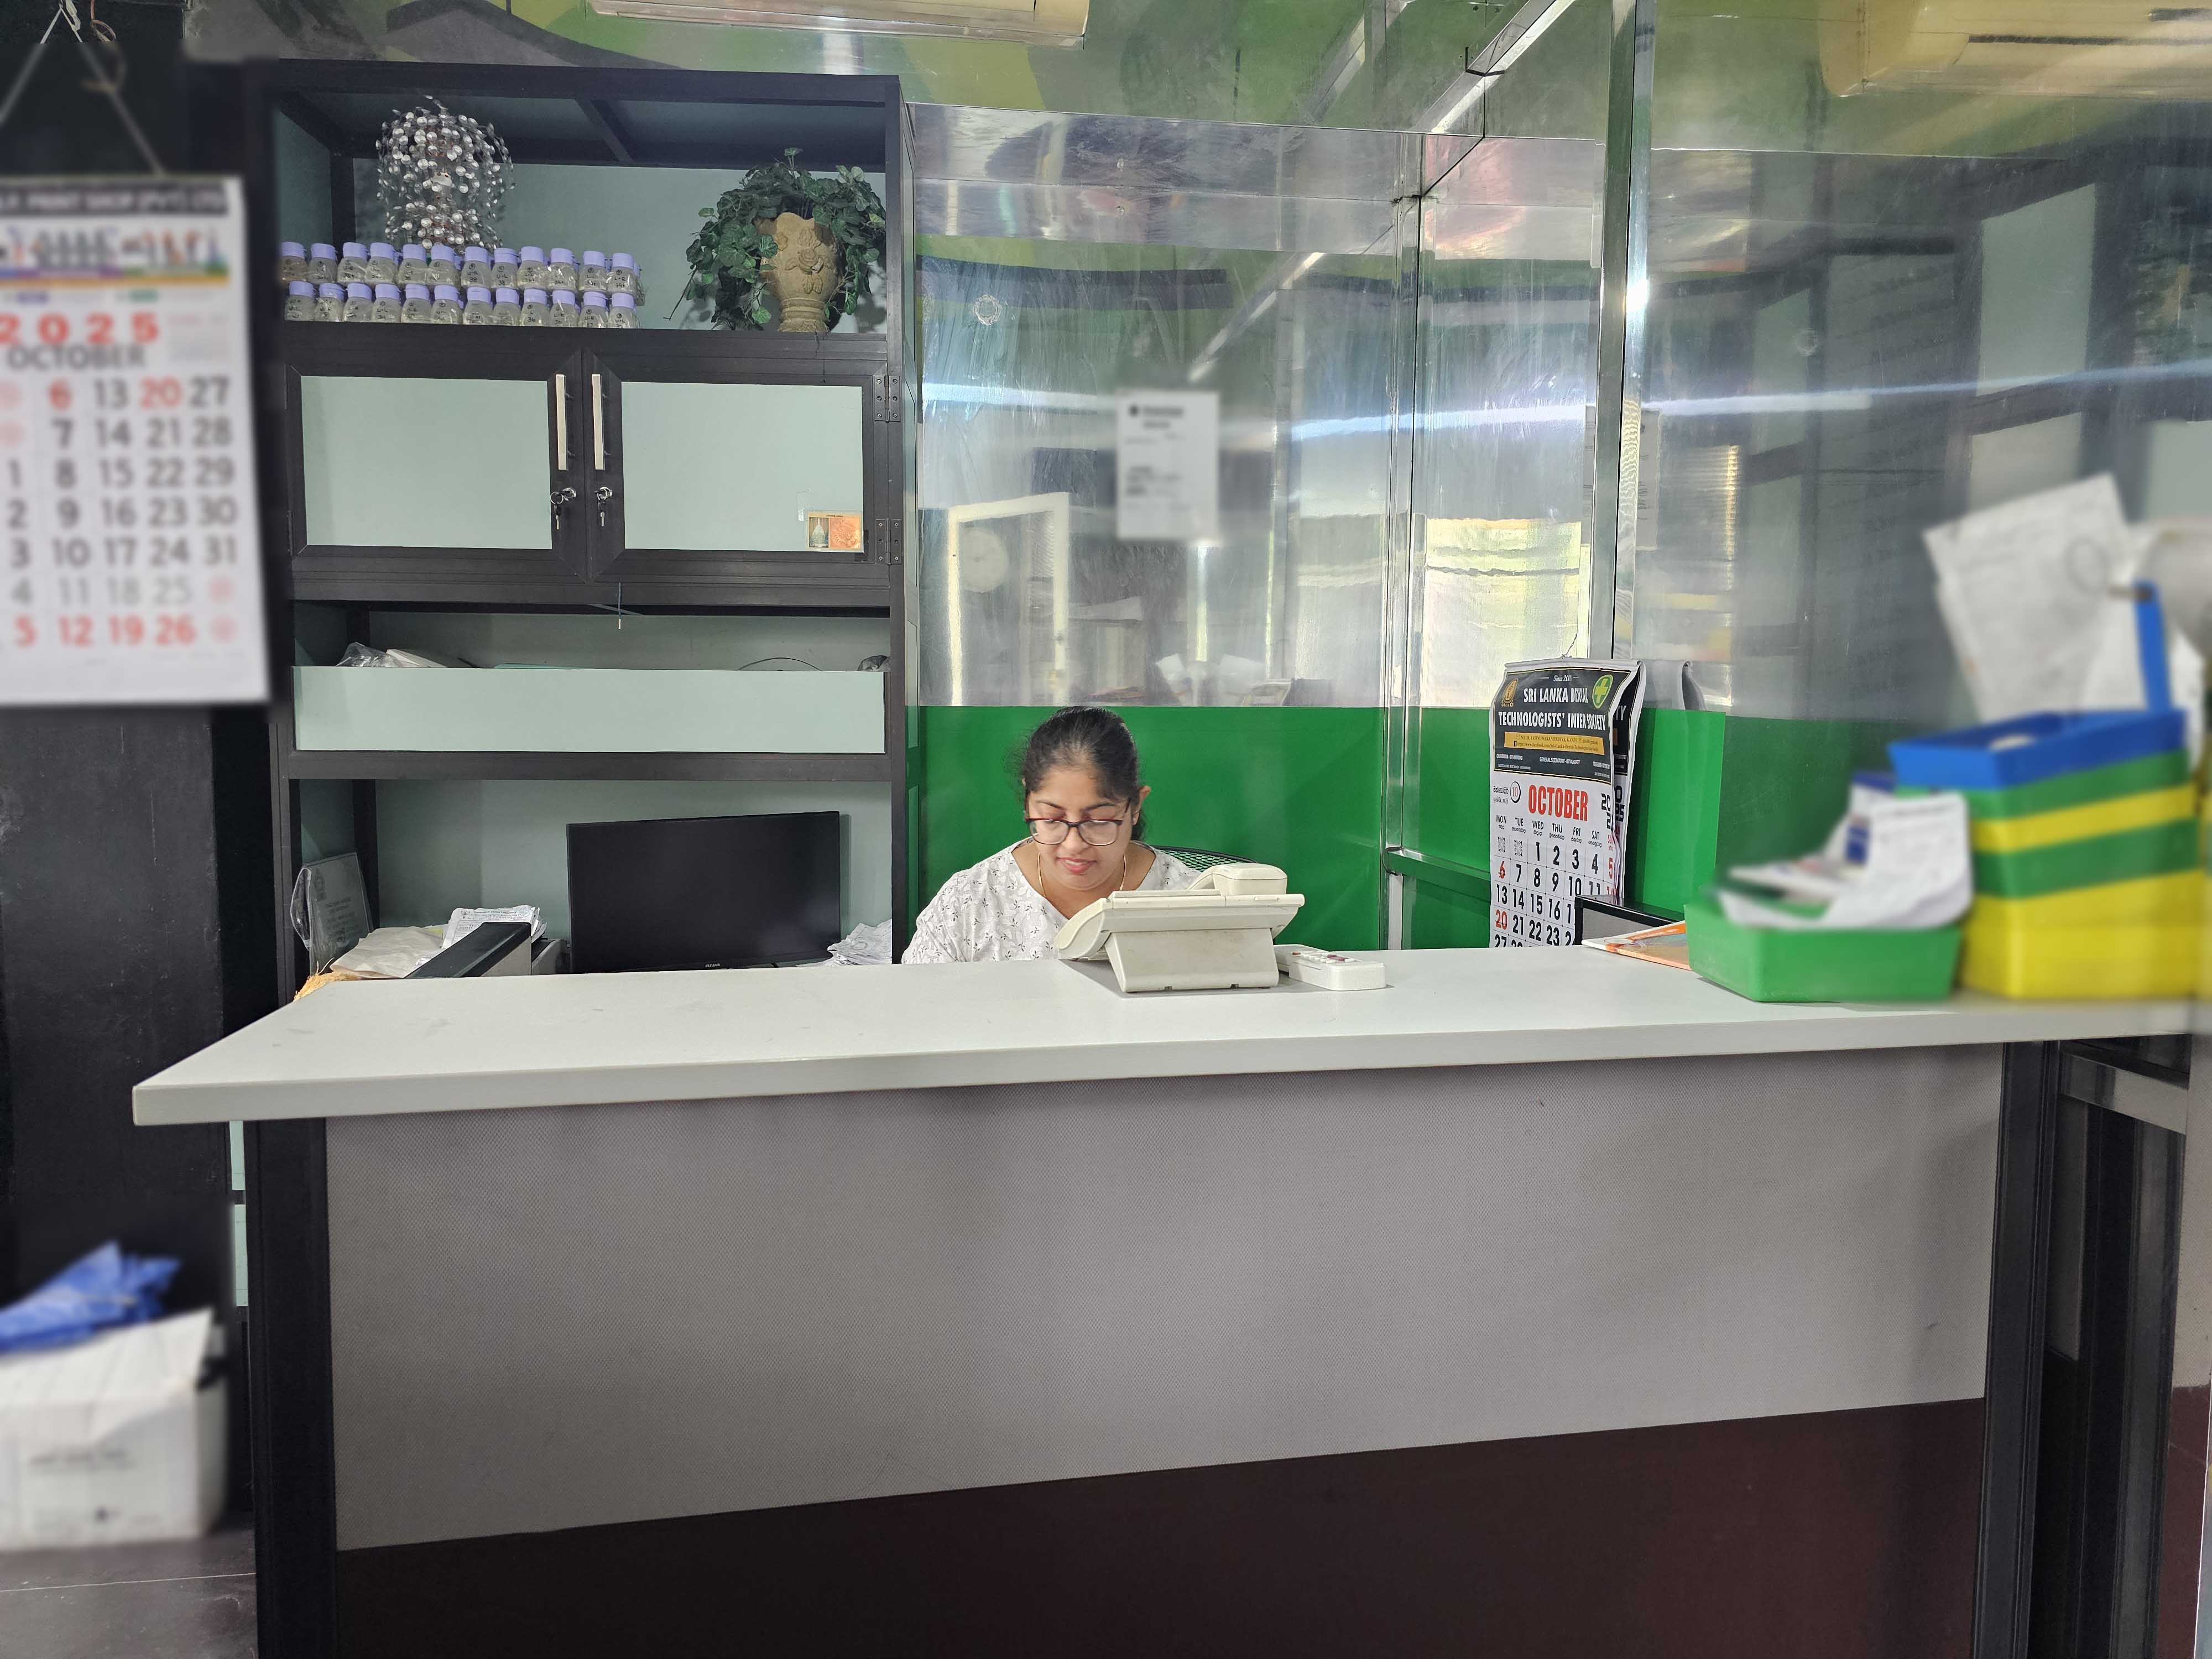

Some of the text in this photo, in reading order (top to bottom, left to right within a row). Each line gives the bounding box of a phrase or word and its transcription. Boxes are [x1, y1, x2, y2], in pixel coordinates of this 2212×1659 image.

[0, 314, 159, 345] 2025
[7, 345, 145, 369] OCTOBER
[49, 377, 228, 411] 6 13 20 27
[53, 415, 231, 448] 7 14 21 28
[9, 456, 235, 488] 1 8 15 22 29
[8, 498, 238, 529] 2 9 16 23 30
[11, 536, 237, 568] 3 10 17 24 31
[14, 614, 196, 647] 5 12 19 26
[1524, 687, 1589, 703] SRI LANKA DENTAL
[1498, 712, 1606, 731] TECHNOLOGISTS' INTER SOCIETY
[1512, 787, 1519, 797] 10
[1528, 785, 1588, 821] OCTOBER
[1496, 815, 1507, 823] MON
[1515, 817, 1524, 826] TUE
[1532, 820, 1543, 830] WED
[1552, 823, 1563, 833] THU
[1573, 827, 1581, 836] FRI
[1536, 842, 1613, 879] 1 2 3 4 5
[1499, 861, 1505, 879] 6
[1516, 864, 1522, 882] 7
[1533, 868, 1540, 888] 8
[1552, 873, 1559, 891] 9
[1569, 876, 1582, 896] 10
[1589, 881, 1600, 895] 11
[1496, 884, 1571, 924] 13 14 15 16 1
[1495, 909, 1507, 930] 20
[1512, 915, 1524, 935] 21
[1529, 920, 1542, 941] 22
[1547, 925, 1559, 946] 23
[1495, 934, 1507, 947] 27
